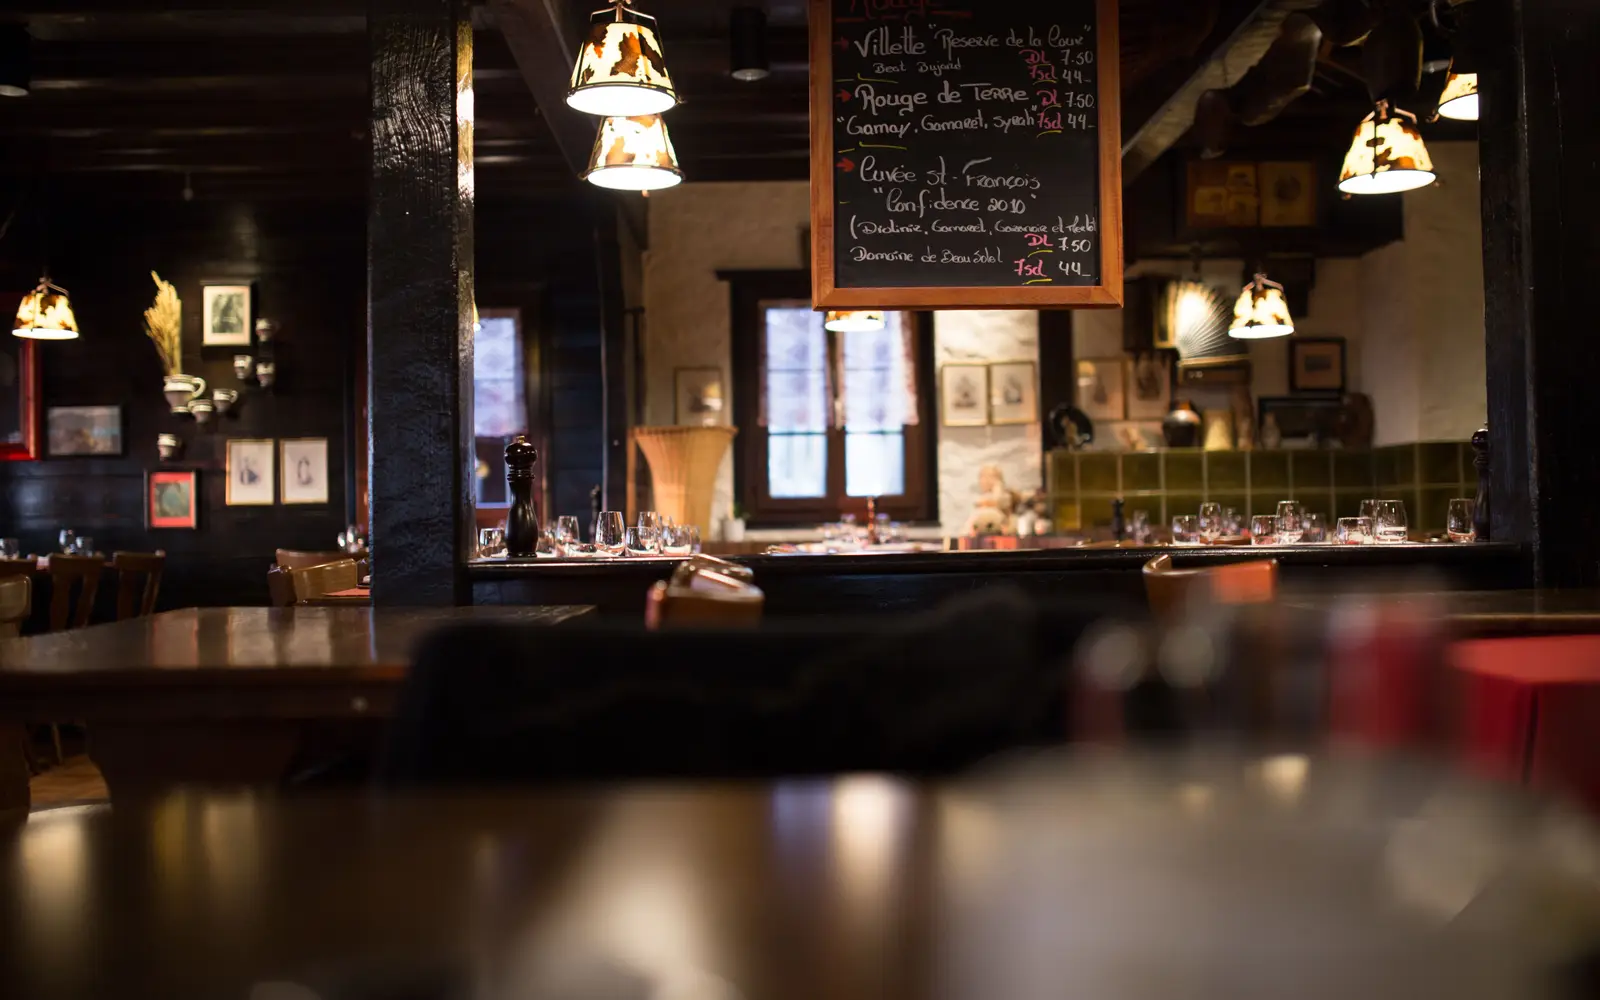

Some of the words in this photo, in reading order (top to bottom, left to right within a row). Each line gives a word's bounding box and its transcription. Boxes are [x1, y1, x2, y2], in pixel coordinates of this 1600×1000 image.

[854, 25, 927, 58] Villette
[1006, 28, 1025, 47] de
[1029, 25, 1042, 47] la
[873, 61, 907, 74] Beat
[917, 57, 962, 77] Bujard
[1061, 49, 1094, 66] 7.50
[855, 84, 928, 116] Rouge
[938, 80, 963, 103] de
[860, 155, 917, 183] Cuvée
[1051, 215, 1065, 233] et
[849, 245, 914, 262] Domaine
[921, 245, 937, 263] de
